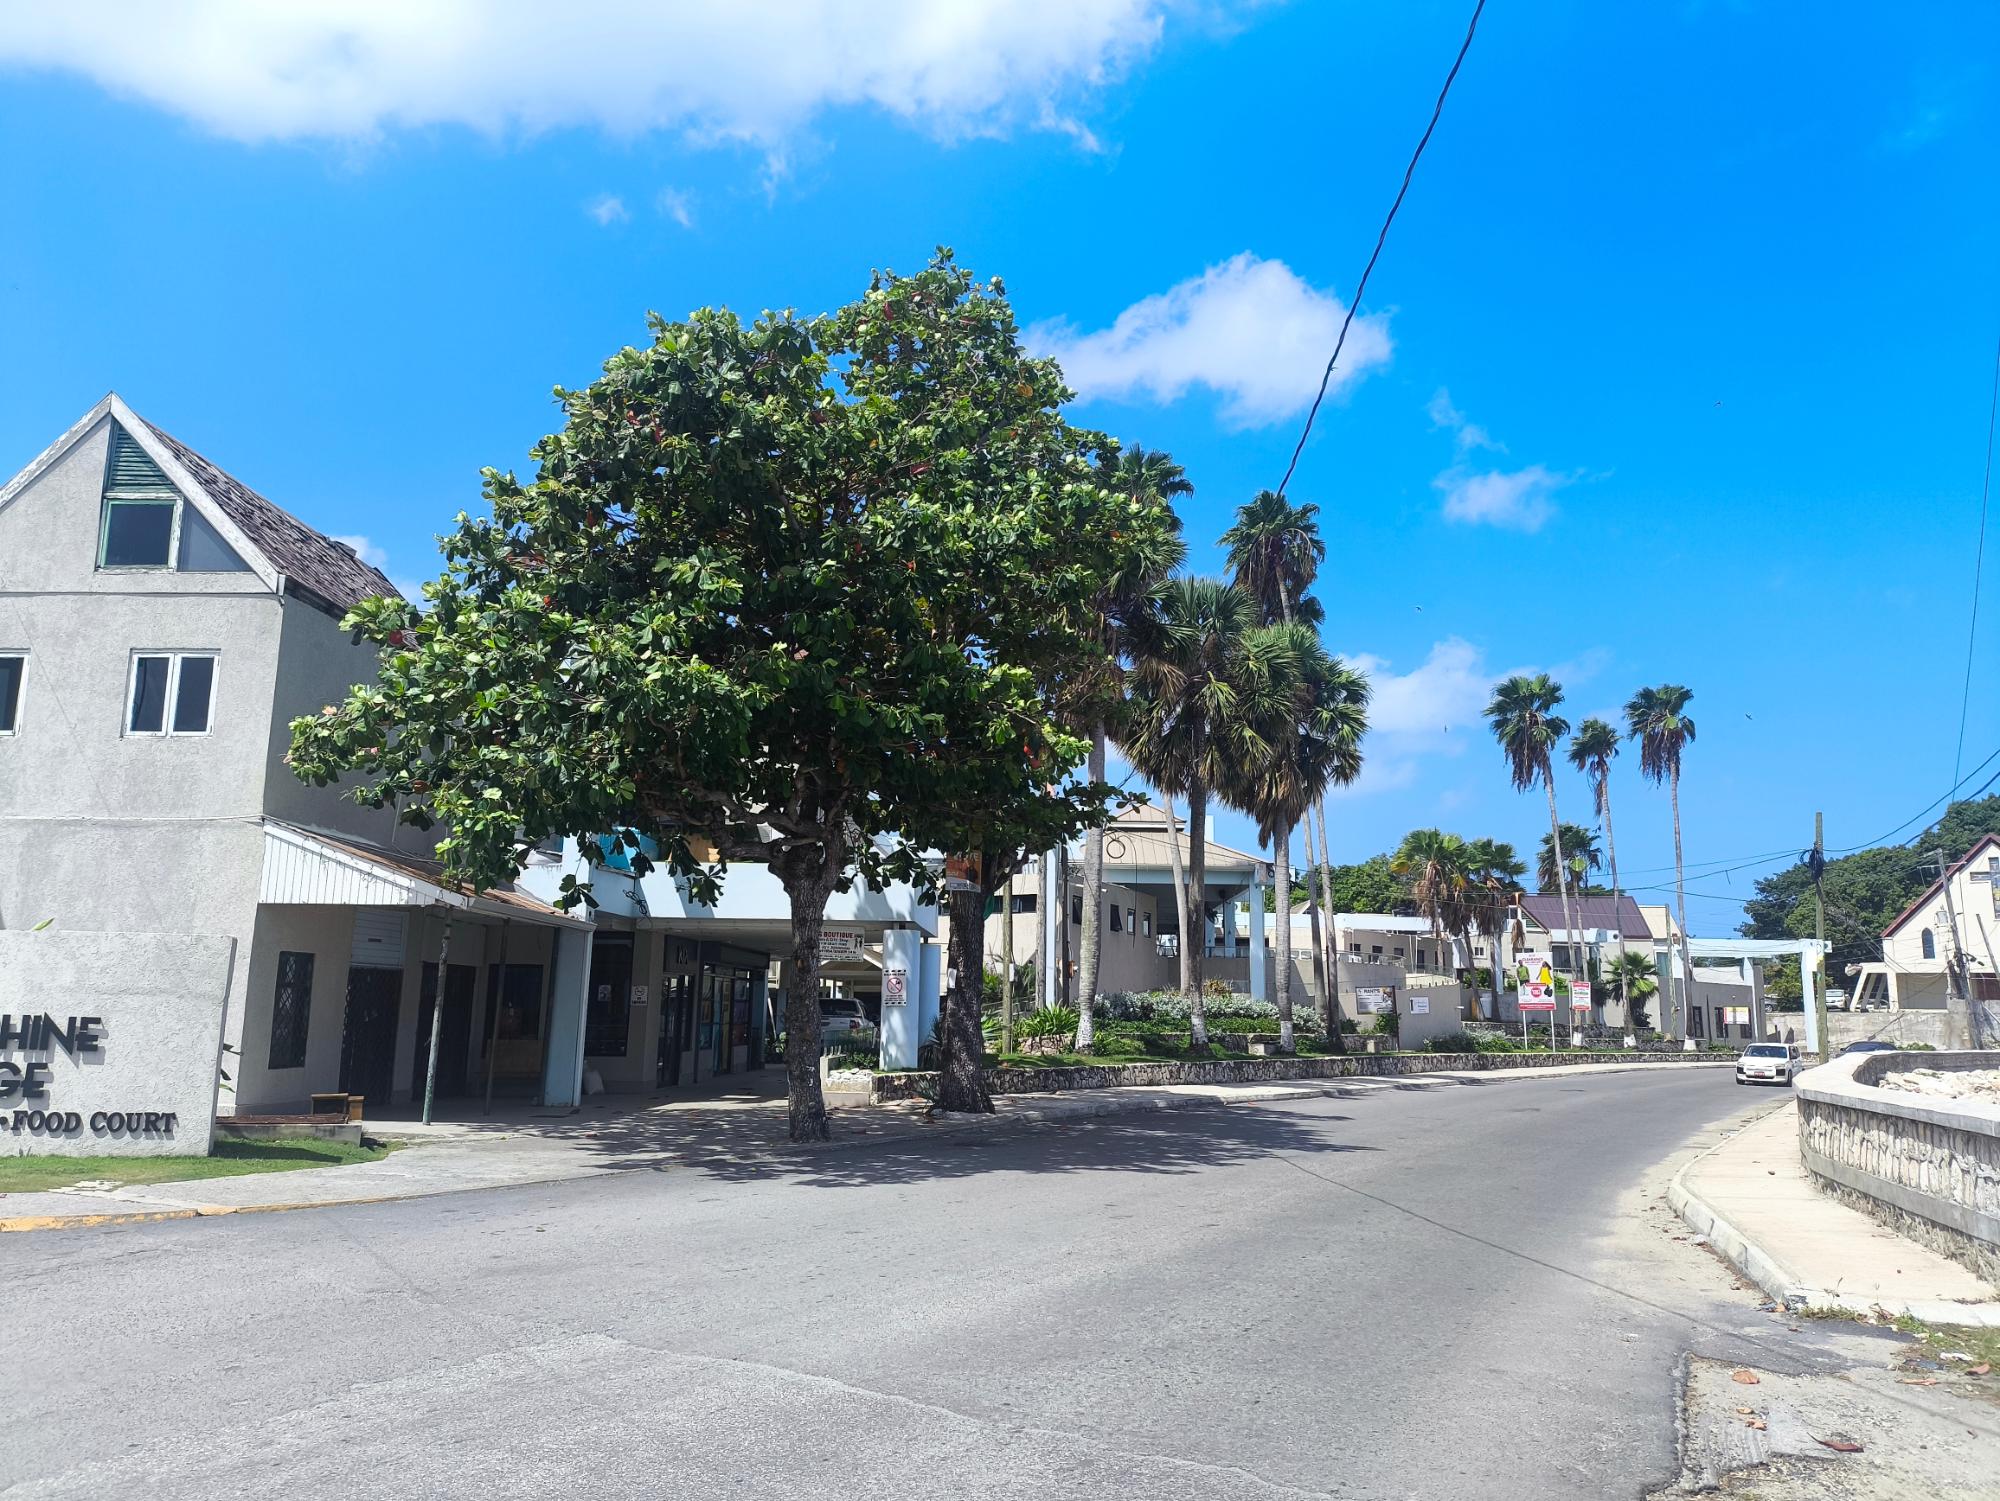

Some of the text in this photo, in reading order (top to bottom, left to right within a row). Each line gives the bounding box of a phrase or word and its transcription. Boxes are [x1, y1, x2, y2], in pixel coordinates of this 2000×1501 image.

[0, 1012, 102, 1056] HINE
[11, 1110, 176, 1133] FOOD COURT
